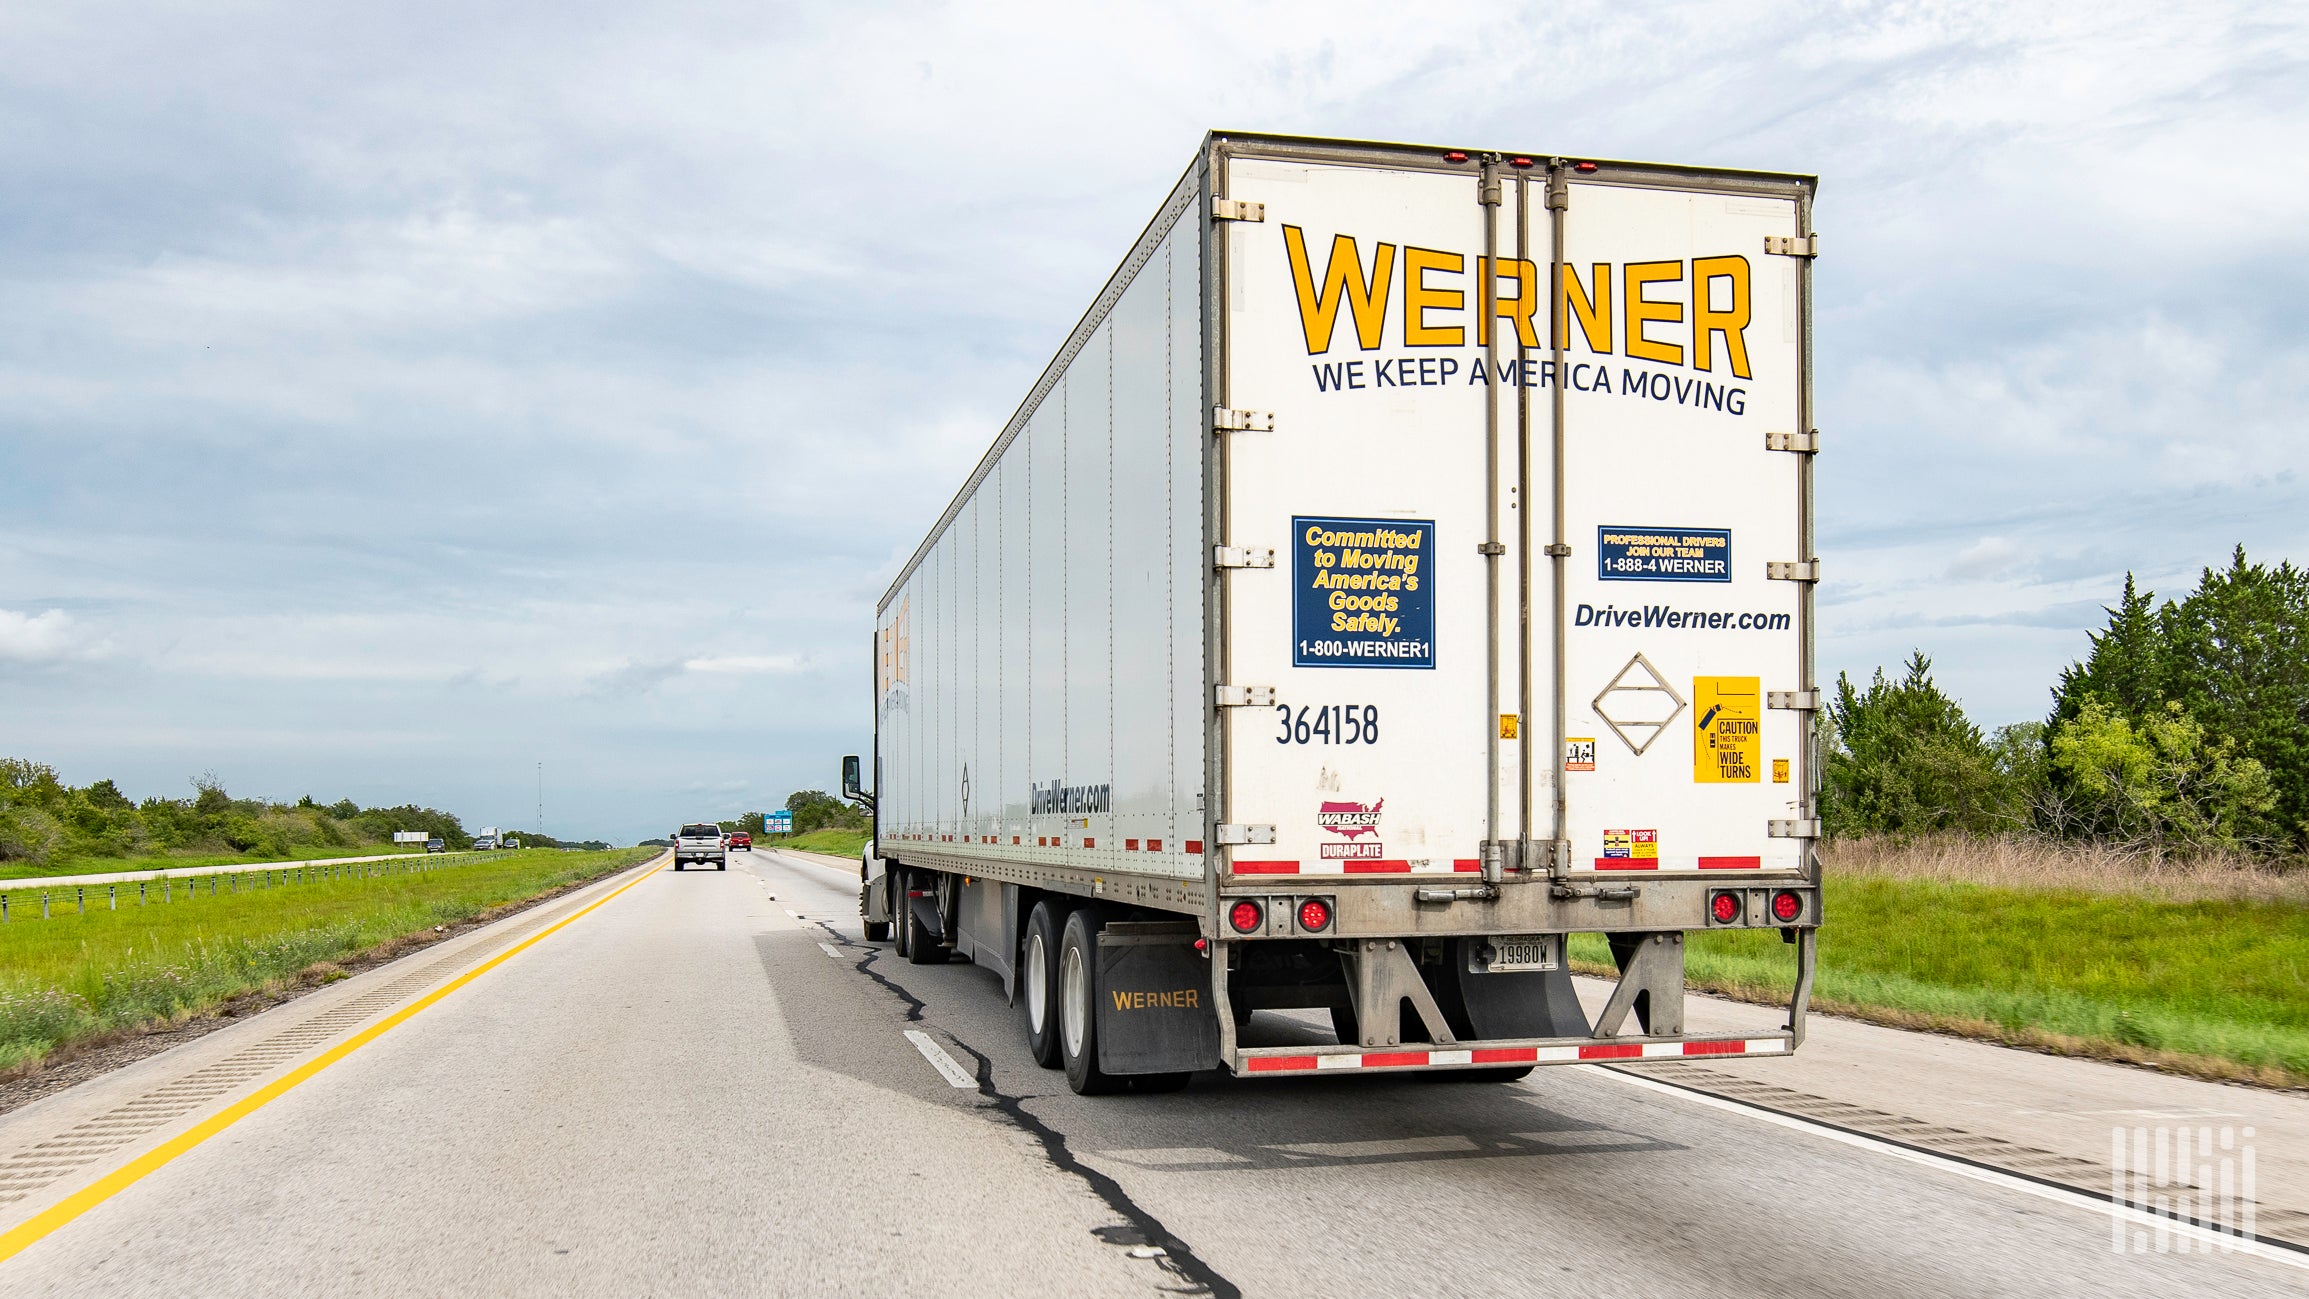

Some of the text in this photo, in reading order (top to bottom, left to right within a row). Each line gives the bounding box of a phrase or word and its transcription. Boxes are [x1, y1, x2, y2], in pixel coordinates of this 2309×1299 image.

[1281, 223, 1753, 380] WERNER
[1312, 357, 1747, 416] WE KEEP AMERICA MOVING
[1305, 526, 1422, 549] Committed
[1603, 534, 1726, 548] PROFESSIONAL DRIVERS
[1314, 549, 1419, 574] to Moving
[1626, 547, 1704, 558] JOIN OUR TEAM
[1604, 558, 1726, 574] 1-888-4 WERNER
[1312, 569, 1419, 591] America's
[1328, 591, 1399, 611] Goods
[1331, 612, 1401, 637] Safely.
[1575, 604, 1791, 630] DriveWerner.com
[1299, 640, 1429, 658] 1-800-WERNER1
[1276, 704, 1379, 745] 364158
[1719, 721, 1758, 735] CAUTION
[1720, 751, 1744, 765] WIDE
[1720, 765, 1751, 779] TURNS
[1031, 779, 1110, 815] DriveWerner.com
[1318, 813, 1381, 825] WABASH
[1322, 844, 1381, 857] DURAPLATE
[1112, 989, 1199, 1012] WERNER
